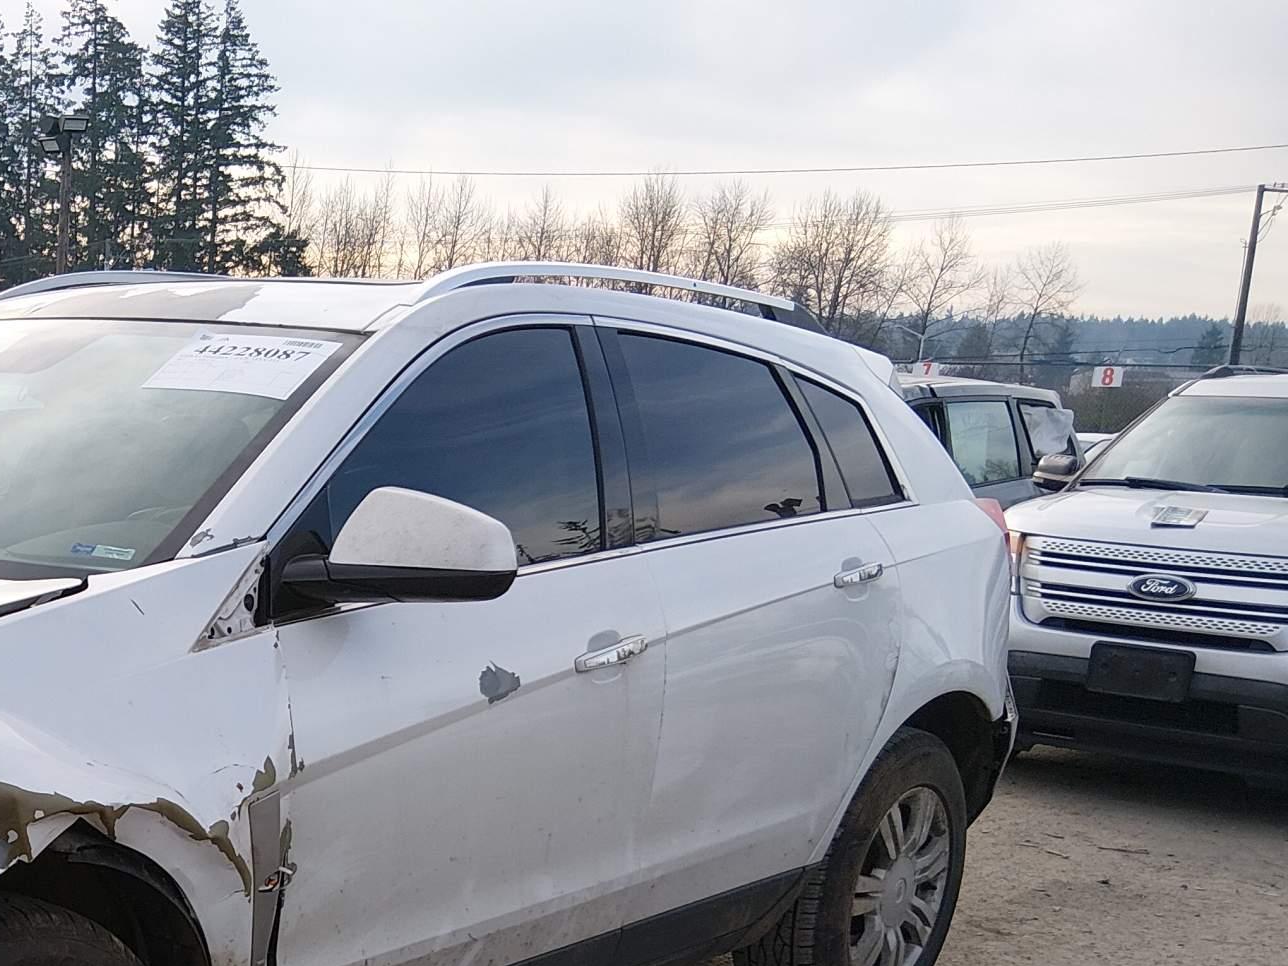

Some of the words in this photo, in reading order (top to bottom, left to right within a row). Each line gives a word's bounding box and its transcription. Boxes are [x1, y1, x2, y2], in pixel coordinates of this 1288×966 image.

[194, 344, 312, 361] 44228087
[922, 362, 933, 376] 7
[1101, 367, 1114, 385] 8
[1140, 578, 1178, 594] Ford
